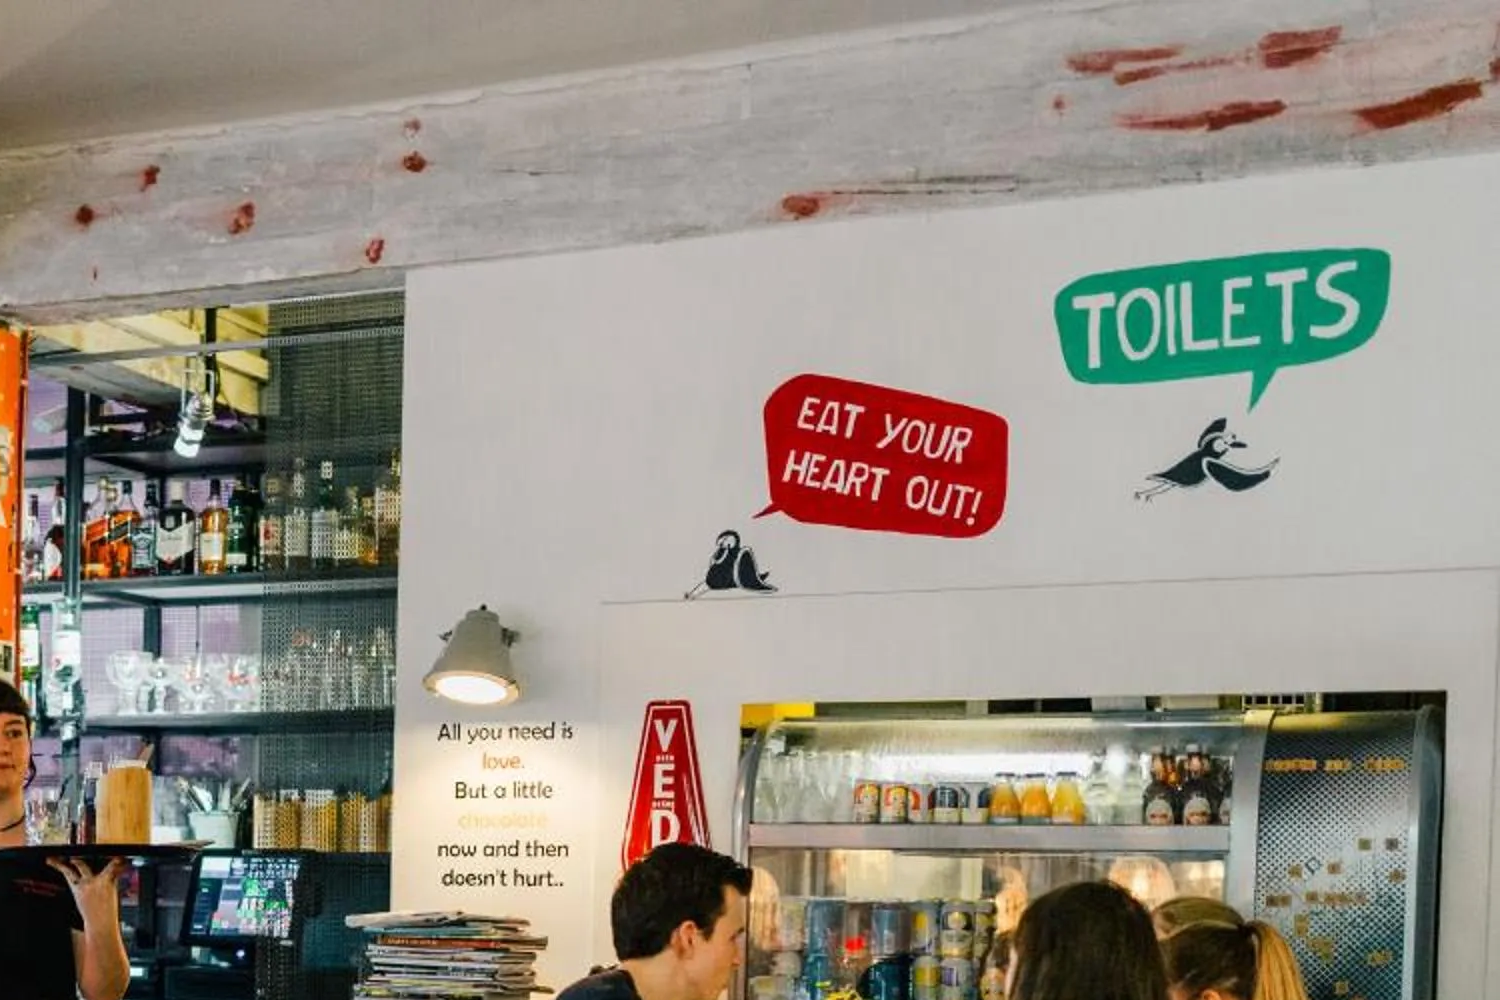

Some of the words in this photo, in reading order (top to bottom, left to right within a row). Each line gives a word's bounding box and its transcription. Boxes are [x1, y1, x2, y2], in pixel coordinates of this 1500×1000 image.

[1073, 260, 1358, 369] TOILETS
[797, 396, 865, 439] EAT
[876, 413, 973, 464] YOUR
[782, 450, 890, 501] HEART
[905, 475, 982, 526] OUT!
[438, 722, 461, 742] All
[467, 726, 502, 745] you
[508, 721, 556, 740] need
[562, 721, 574, 740] is
[482, 751, 525, 770] love.
[455, 781, 488, 799] But
[494, 785, 507, 799] a
[513, 780, 553, 799] little
[437, 844, 477, 857] now
[483, 839, 520, 857] and
[525, 839, 569, 857] then
[442, 868, 508, 887] doesn't
